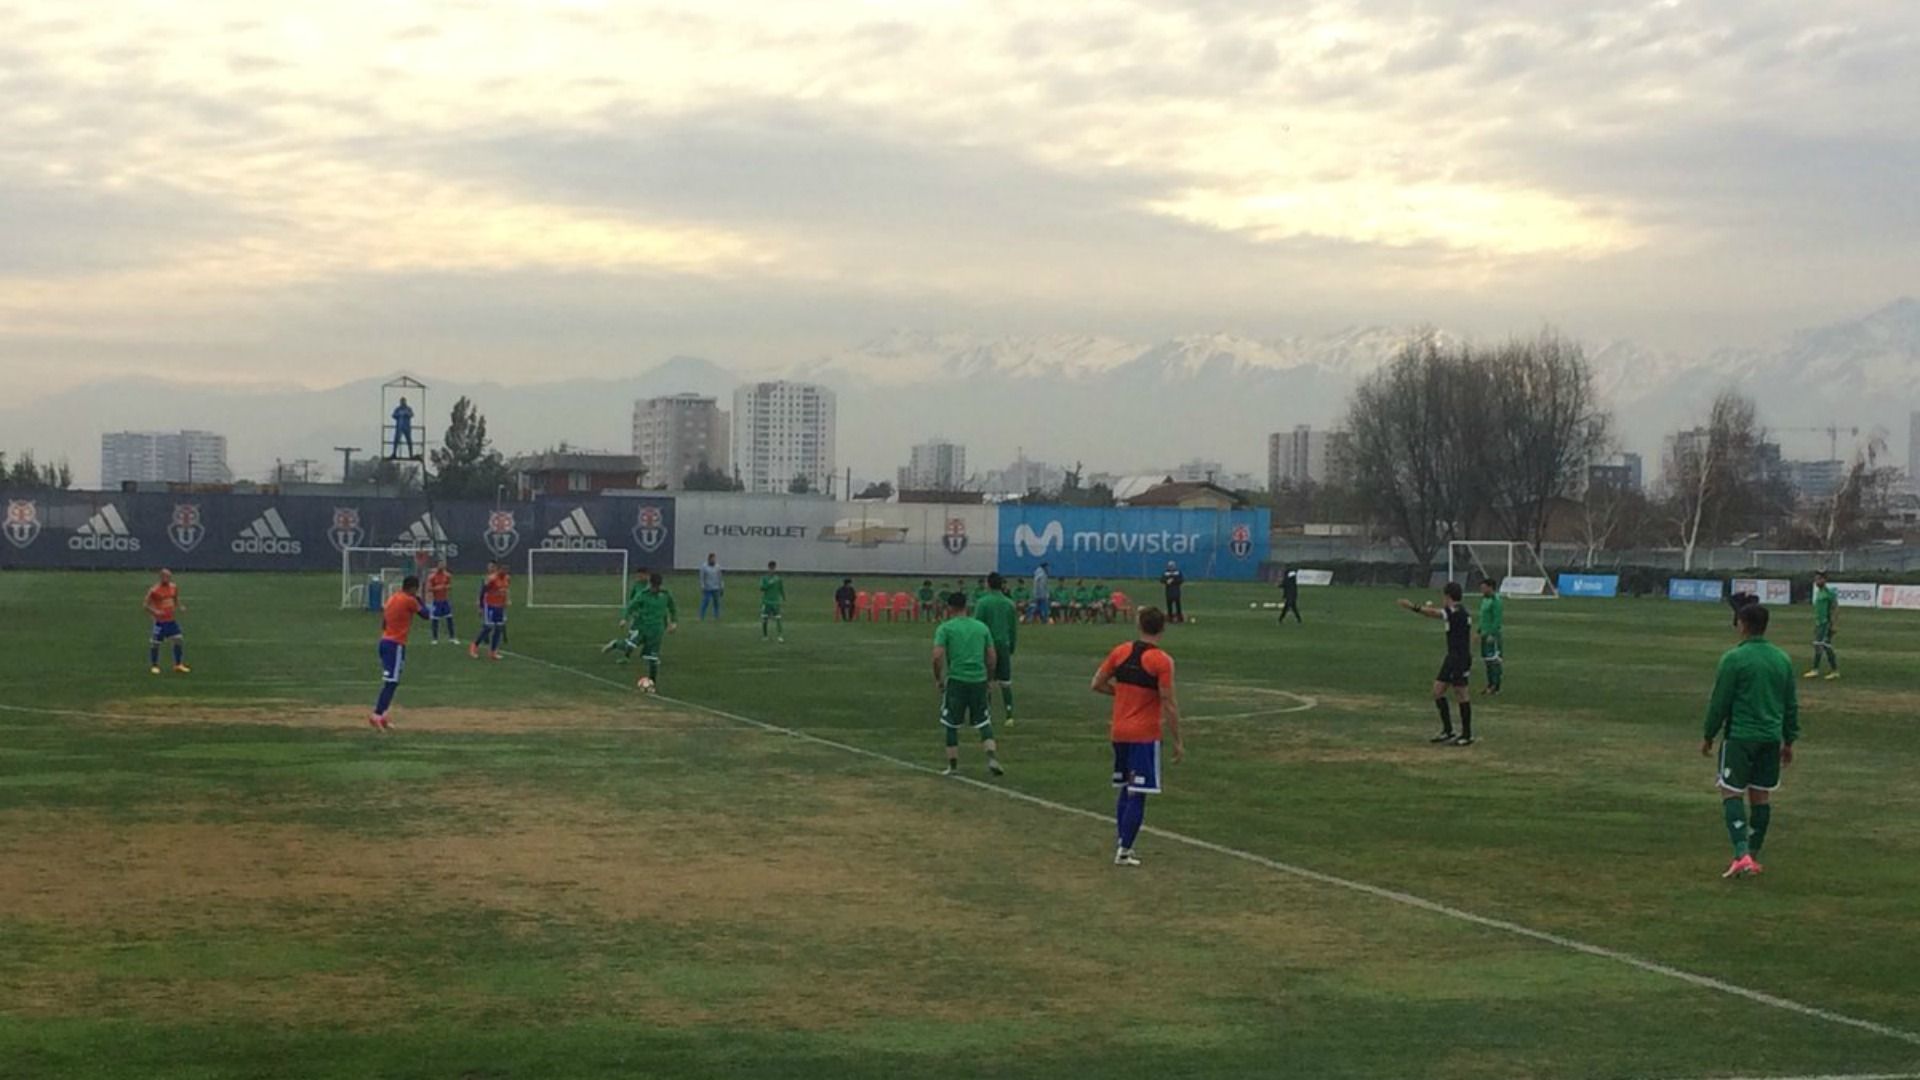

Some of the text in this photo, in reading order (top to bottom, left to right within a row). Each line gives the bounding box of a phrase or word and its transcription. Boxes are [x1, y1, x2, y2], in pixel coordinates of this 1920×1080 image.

[703, 524, 808, 538] CHEVROLET
[68, 535, 141, 552] adidas
[231, 537, 302, 555] adidas
[540, 536, 608, 550] adidas
[1073, 528, 1200, 554] movistar
